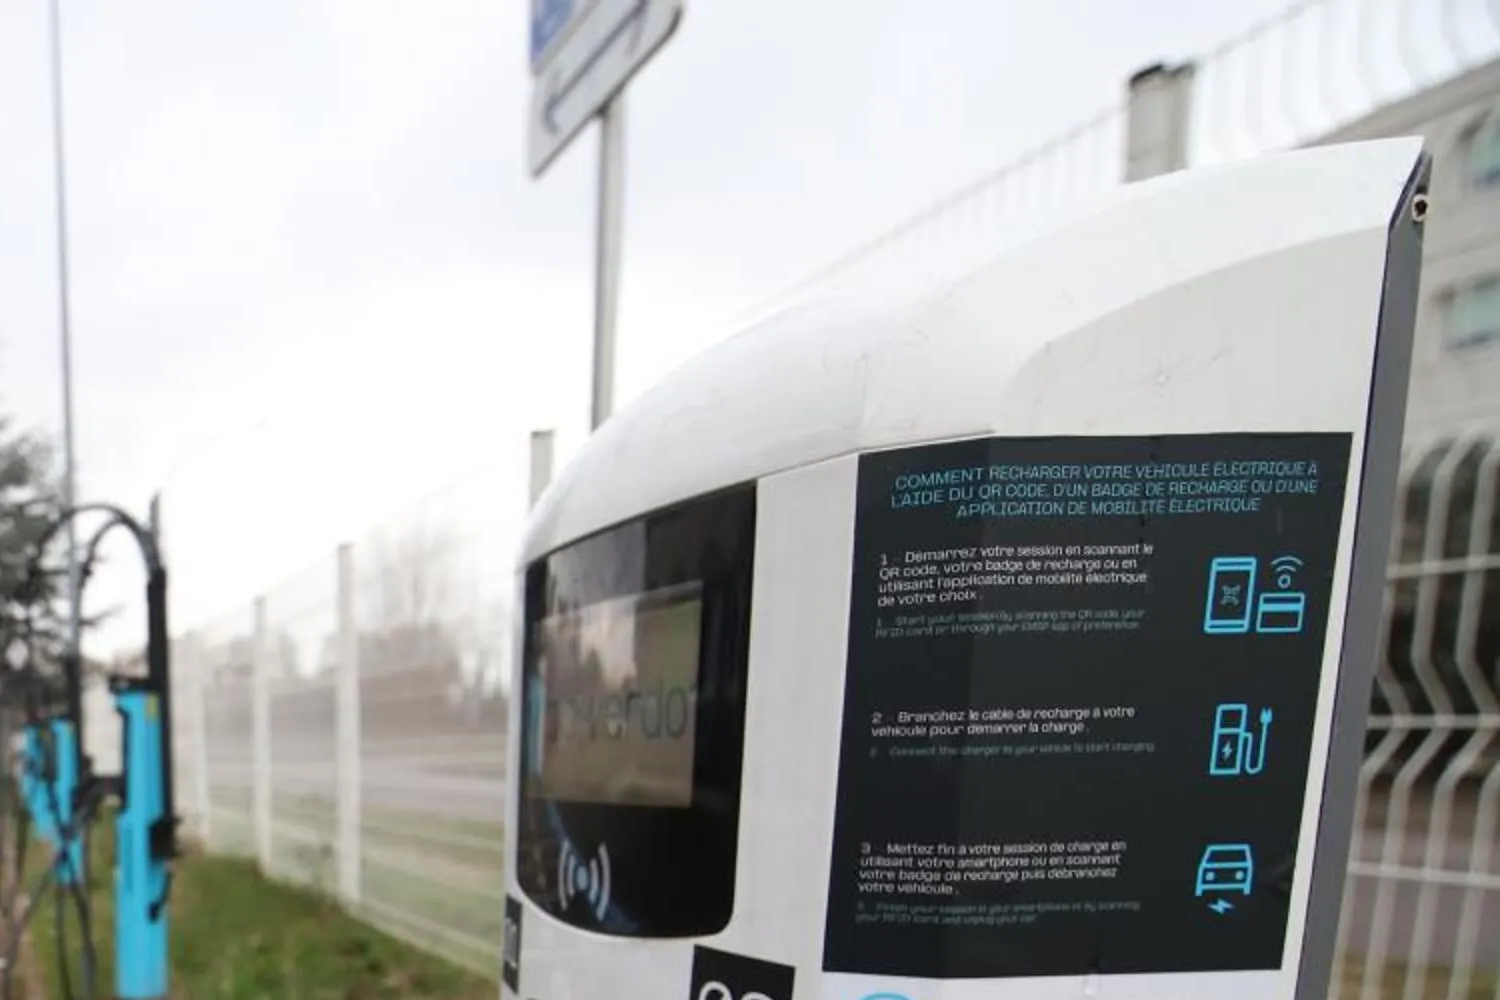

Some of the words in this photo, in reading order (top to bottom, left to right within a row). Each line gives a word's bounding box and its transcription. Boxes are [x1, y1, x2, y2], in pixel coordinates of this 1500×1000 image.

[895, 466, 984, 490] COMMENT
[989, 465, 1080, 481] RECHARGER
[1083, 464, 1133, 480] VOTRE
[949, 486, 973, 502] DU
[979, 484, 1002, 500] QR
[1091, 482, 1142, 498] BADGE
[1145, 481, 1166, 497] DE
[1168, 480, 1249, 496] RECHARGE
[1251, 479, 1273, 495] OU
[956, 500, 1064, 519] APPLICATION
[1067, 500, 1087, 516] DE
[980, 545, 1015, 558] votre
[1017, 544, 1063, 557] session
[1065, 544, 1081, 557] en
[1083, 543, 1141, 556] scannant
[879, 566, 900, 581] QR
[943, 561, 983, 576] votre
[985, 559, 1024, 574] badge
[1026, 559, 1042, 571] de
[1043, 559, 1101, 573] recharge
[1103, 559, 1119, 570] ou
[1121, 558, 1138, 569] en
[879, 577, 935, 593] utilisant
[1017, 573, 1033, 585] de
[877, 595, 895, 608] de
[897, 592, 936, 606] votre
[898, 709, 966, 724] Branchez
[1017, 707, 1033, 721] de
[1034, 707, 1091, 722] recharge
[1103, 705, 1136, 719] votre
[929, 724, 965, 740] pour
[887, 842, 935, 856] Mettez
[937, 842, 956, 856] fin
[969, 843, 1001, 856] votre
[1003, 842, 1048, 855] session
[1049, 842, 1066, 855] de
[1067, 840, 1110, 854] charge
[1111, 840, 1127, 853] en
[860, 856, 914, 868] utilisant
[917, 856, 955, 869] votre
[957, 856, 1030, 870] smartphone
[1032, 855, 1048, 868] ou
[1049, 855, 1065, 867] en
[859, 869, 896, 881] votre
[899, 869, 942, 883] badge
[944, 869, 961, 882] de
[963, 870, 1019, 884] recharge
[1021, 869, 1046, 883] puis
[858, 882, 895, 894] votre
